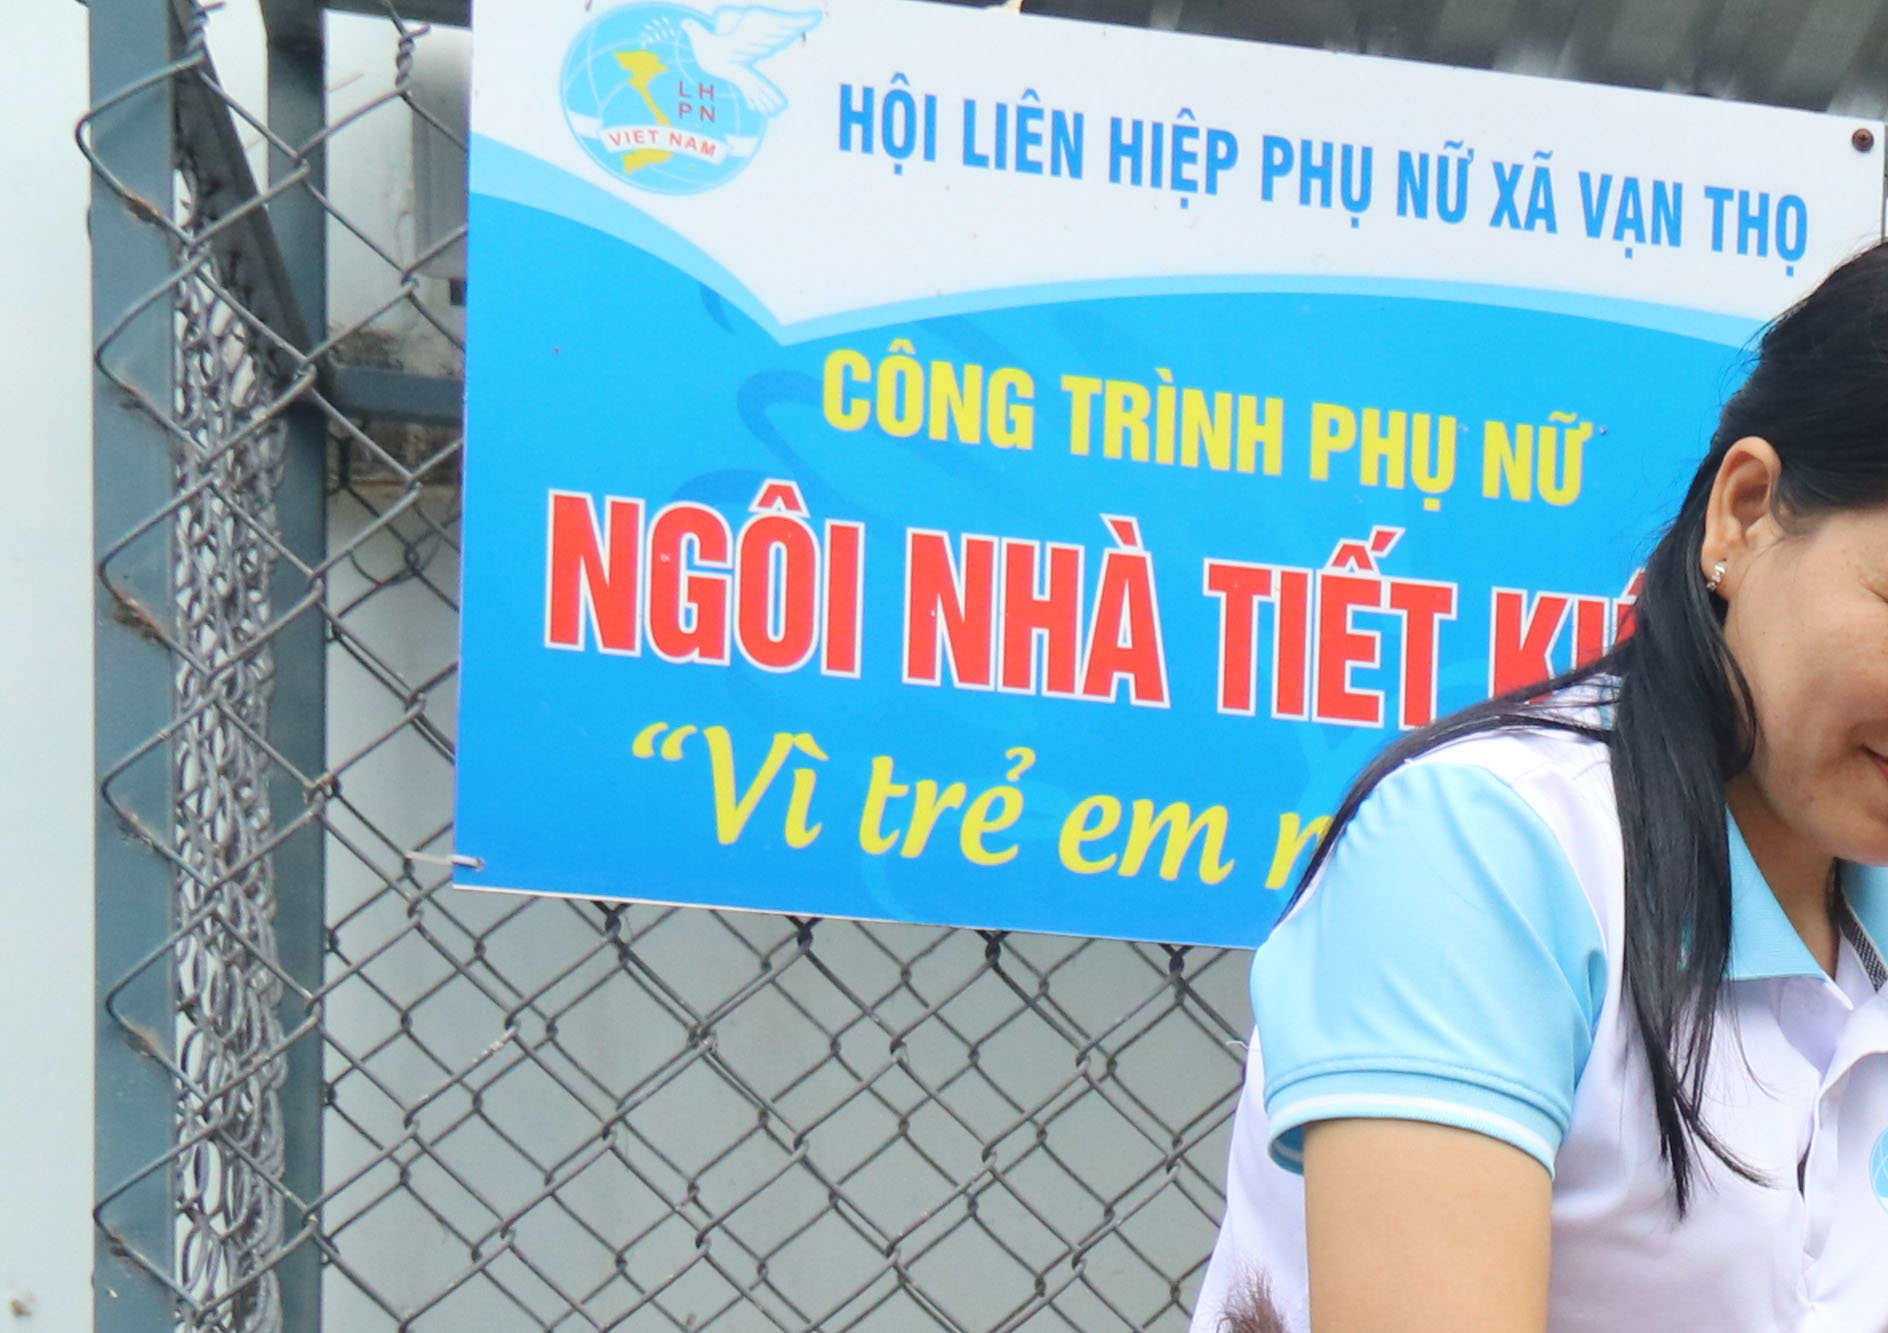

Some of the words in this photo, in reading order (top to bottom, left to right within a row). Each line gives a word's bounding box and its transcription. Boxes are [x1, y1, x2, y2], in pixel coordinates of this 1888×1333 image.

[608, 129, 658, 147] VIET
[669, 131, 716, 157] NAM
[678, 80, 715, 100] LH
[678, 102, 716, 122] PN
[838, 72, 938, 176] HỘI
[962, 88, 1085, 180] LIÊN
[1108, 107, 1239, 209] HIỆP
[1261, 134, 1373, 229] PHỤ
[1396, 139, 1475, 224] NỮ
[1489, 149, 1558, 234] XÃ
[1578, 170, 1684, 259] VẠN
[1703, 185, 1808, 277] THỌ
[822, 338, 1035, 450] CÔNG
[1060, 367, 1285, 477] TRÌNH
[1309, 401, 1457, 511] PHỤ
[1480, 411, 1593, 507] NỮ
[544, 478, 865, 678] NGÔI
[902, 512, 1171, 708] NHÀ
[1202, 525, 1458, 731] TIẾT
[1490, 568, 1645, 703] KI
[858, 746, 1036, 867] trẻ
[1058, 794, 1235, 881] em
